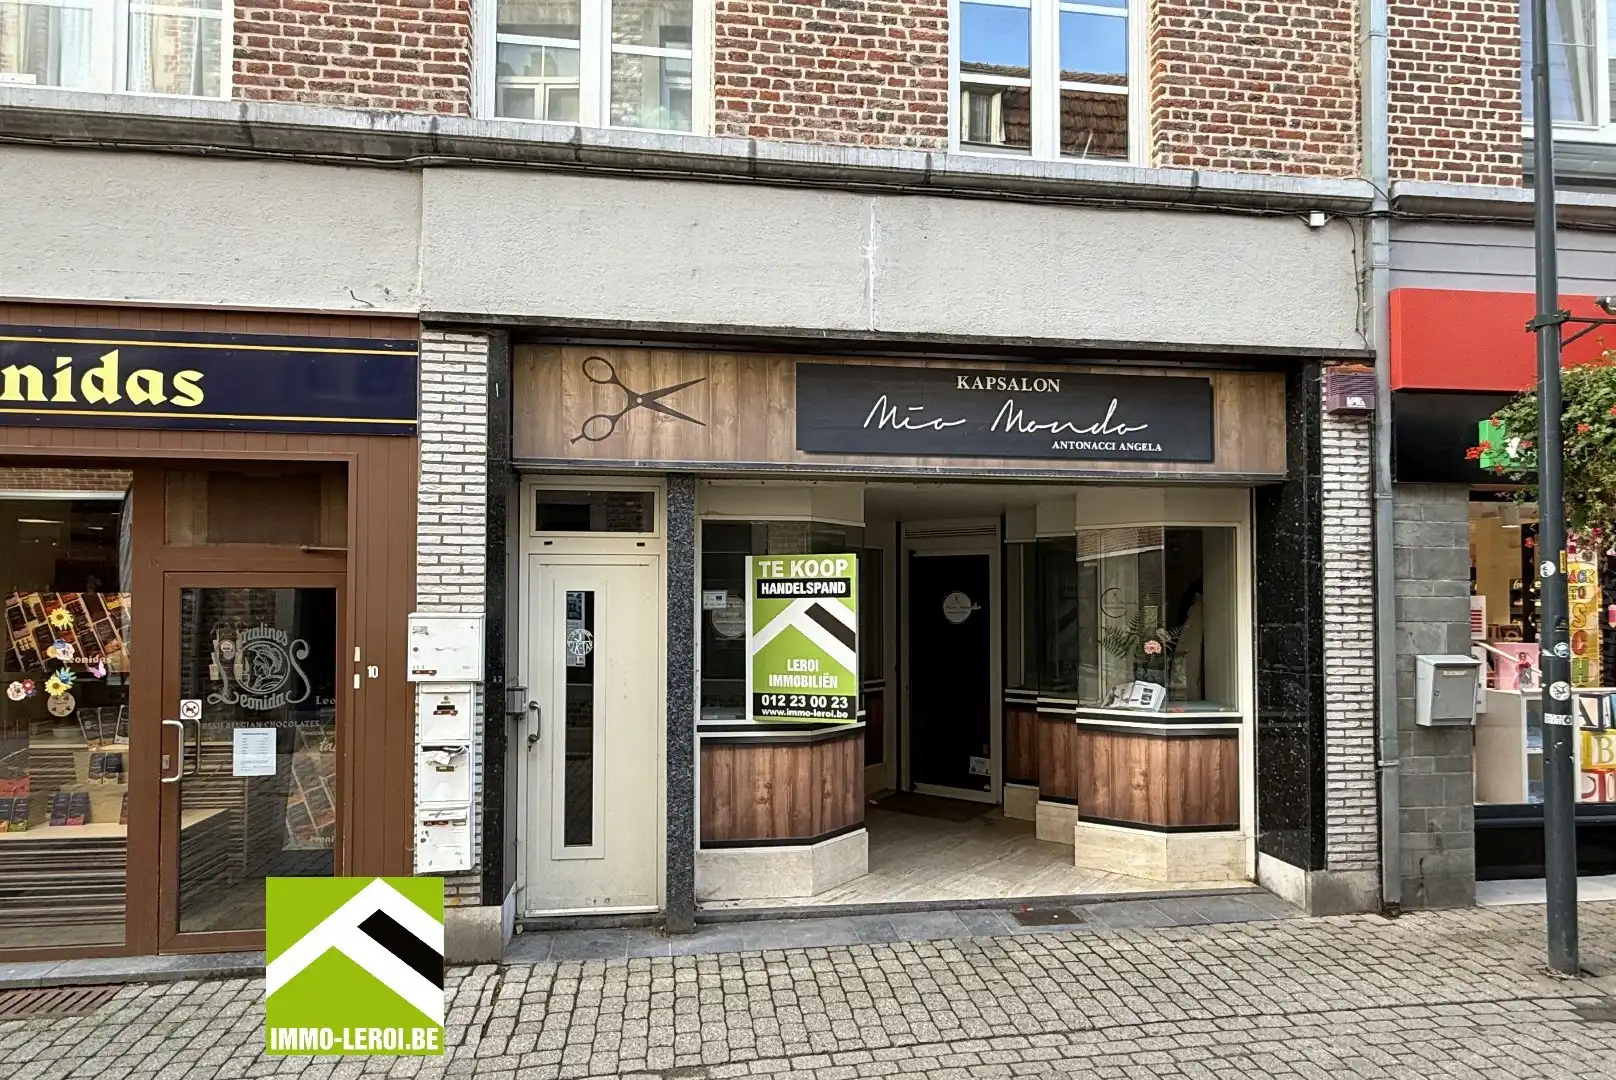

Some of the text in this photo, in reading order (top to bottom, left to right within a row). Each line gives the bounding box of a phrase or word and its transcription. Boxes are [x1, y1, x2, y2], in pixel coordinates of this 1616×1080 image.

[0, 348, 205, 407] nidas
[956, 375, 1060, 393] KAPSALON
[990, 397, 1148, 436] Mondo
[1052, 440, 1162, 452] ANTONACCI ANGELA
[758, 559, 849, 578] TE KOOP
[1567, 569, 1595, 584] ACK
[761, 581, 847, 595] HANDELSPAND
[367, 665, 379, 679] 10
[787, 659, 819, 672] LEROI
[769, 672, 838, 689] IMMOBILIËN
[761, 694, 849, 709] 012 23 00 23
[761, 708, 849, 718] www.immo-leroi.be
[264, 720, 320, 729] CHOCOLATES
